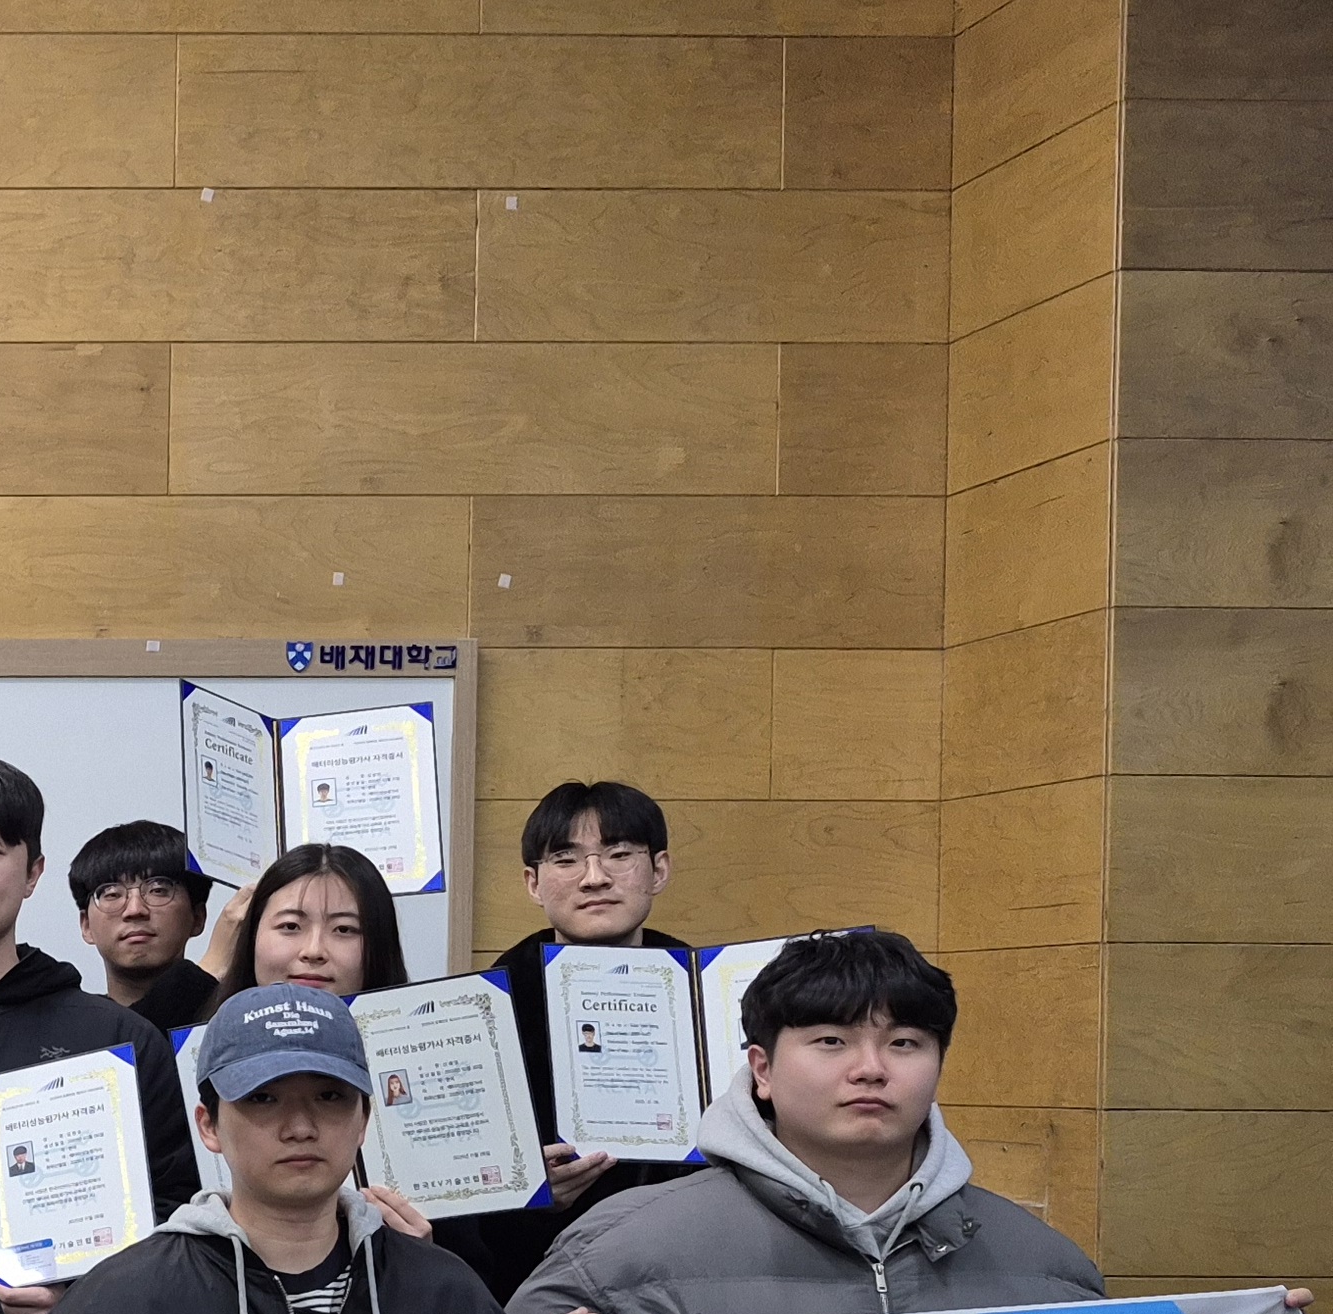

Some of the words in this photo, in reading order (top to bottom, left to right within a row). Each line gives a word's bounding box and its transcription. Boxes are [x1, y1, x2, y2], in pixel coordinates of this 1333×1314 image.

[320, 644, 457, 670] 배재대학교
[205, 738, 253, 765] Certificate
[243, 1001, 291, 1024] Kunst
[582, 999, 657, 1012] Certificate
